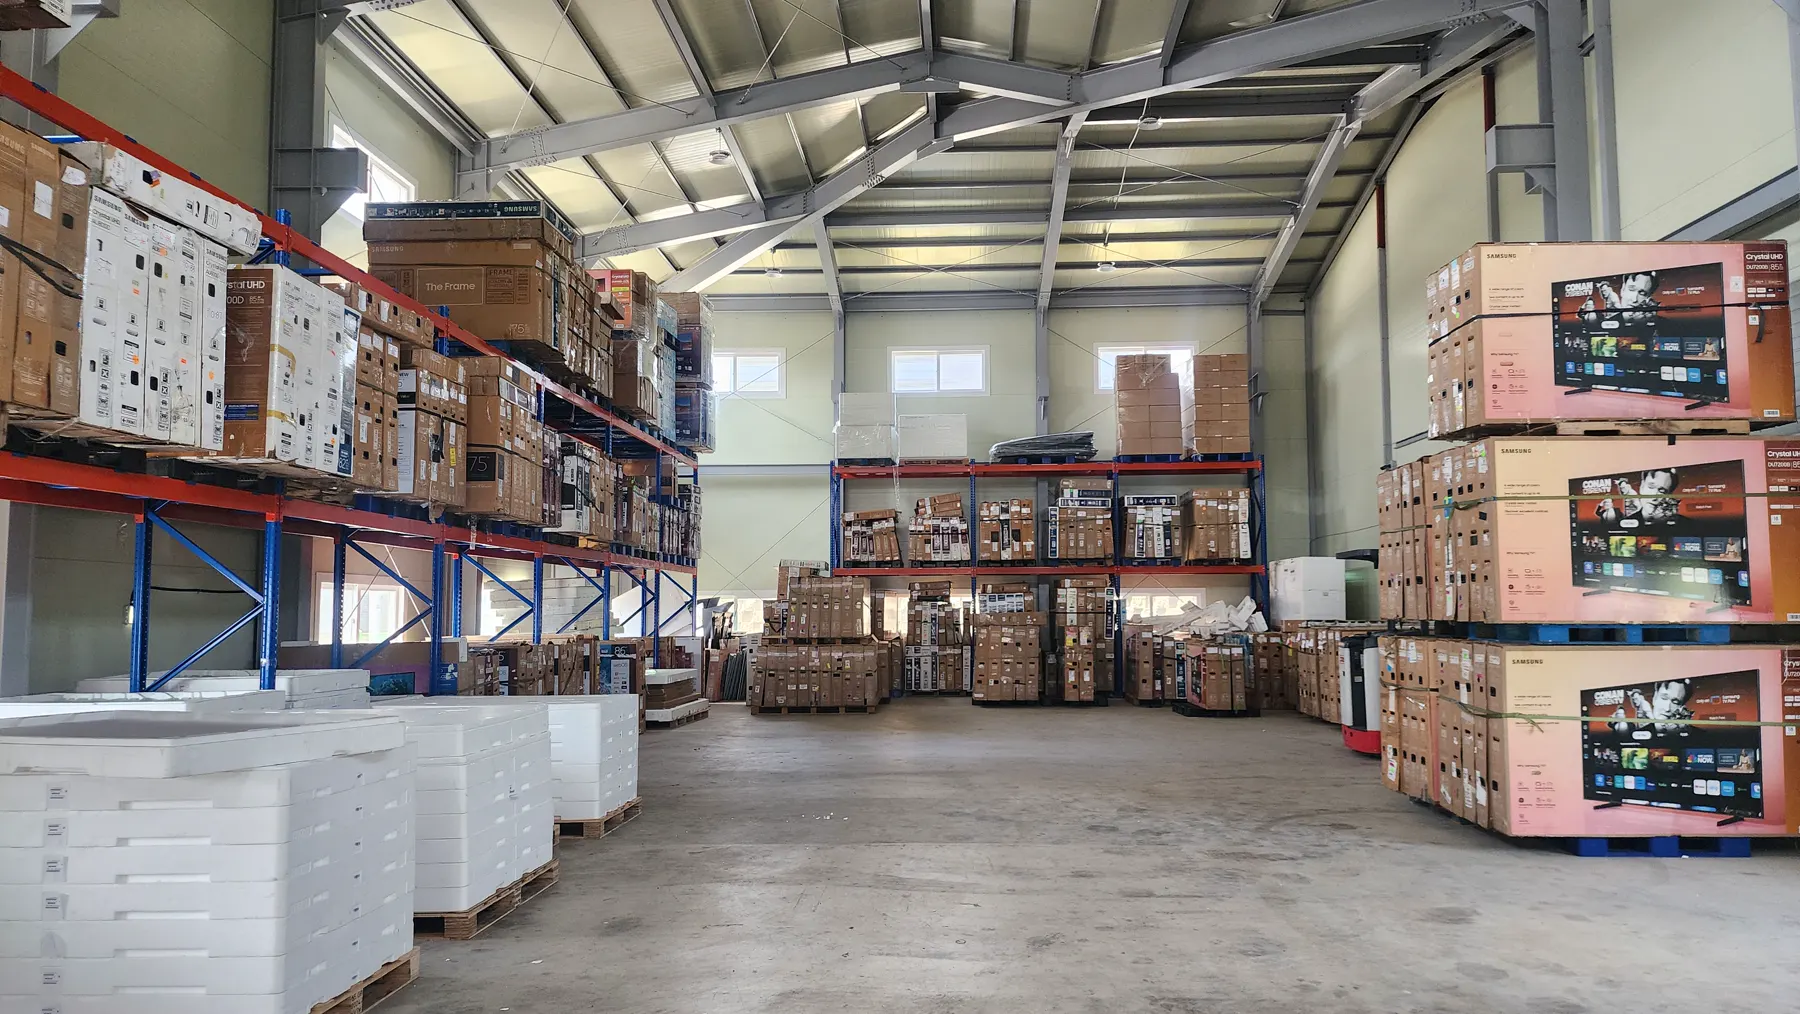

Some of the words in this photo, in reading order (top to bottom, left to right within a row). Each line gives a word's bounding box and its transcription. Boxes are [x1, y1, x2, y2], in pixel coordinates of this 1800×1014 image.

[94, 195, 122, 212] SAMSUNG
[124, 213, 150, 230] SAMSUNG
[1745, 253, 1770, 261] Crystal
[246, 280, 266, 289] UHD
[425, 282, 443, 292] The
[444, 281, 476, 291] Frame
[1767, 450, 1792, 458] Crystal
